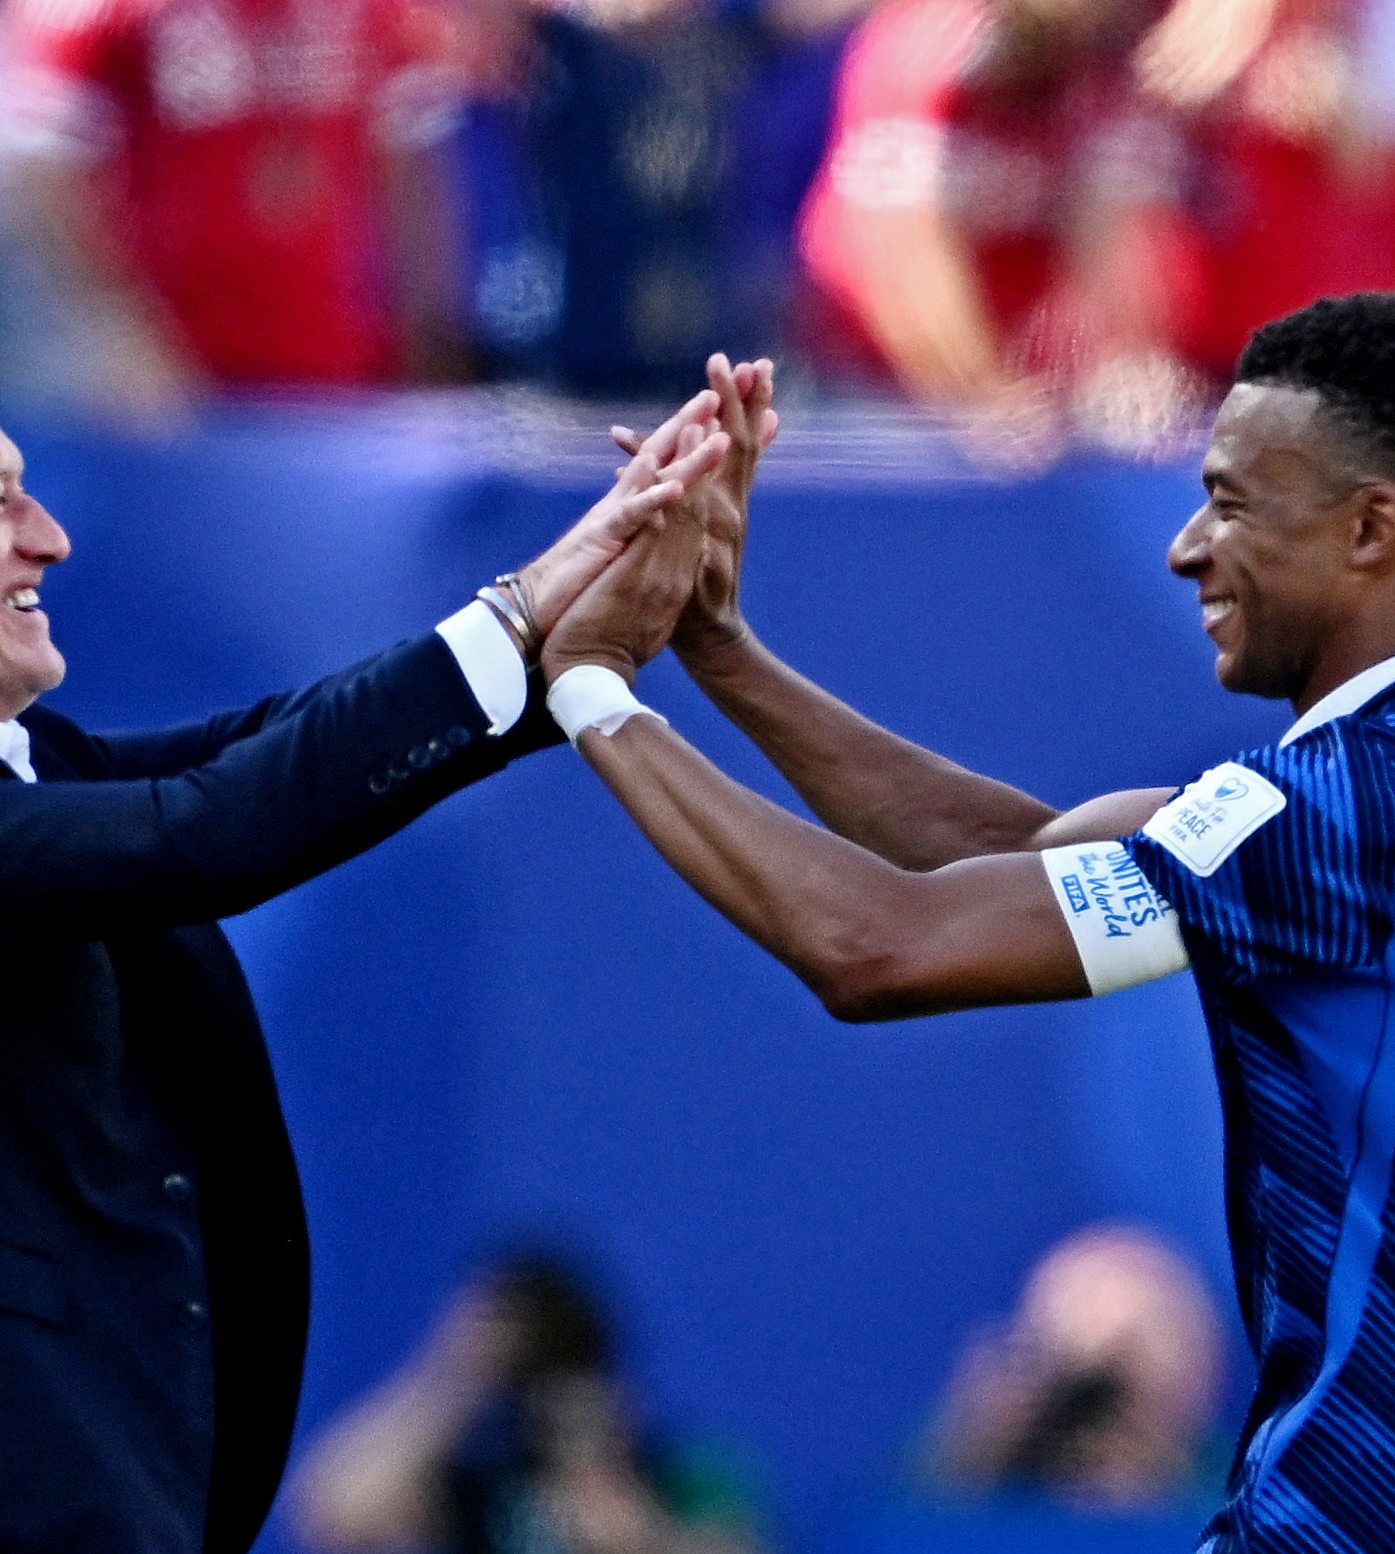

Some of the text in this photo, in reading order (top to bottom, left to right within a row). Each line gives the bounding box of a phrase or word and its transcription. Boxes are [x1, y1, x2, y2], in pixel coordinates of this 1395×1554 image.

[1177, 808, 1212, 840] PEACE
[1062, 874, 1090, 914] FIFA
[1087, 876, 1132, 938] World
[1106, 850, 1157, 927] UNITES
